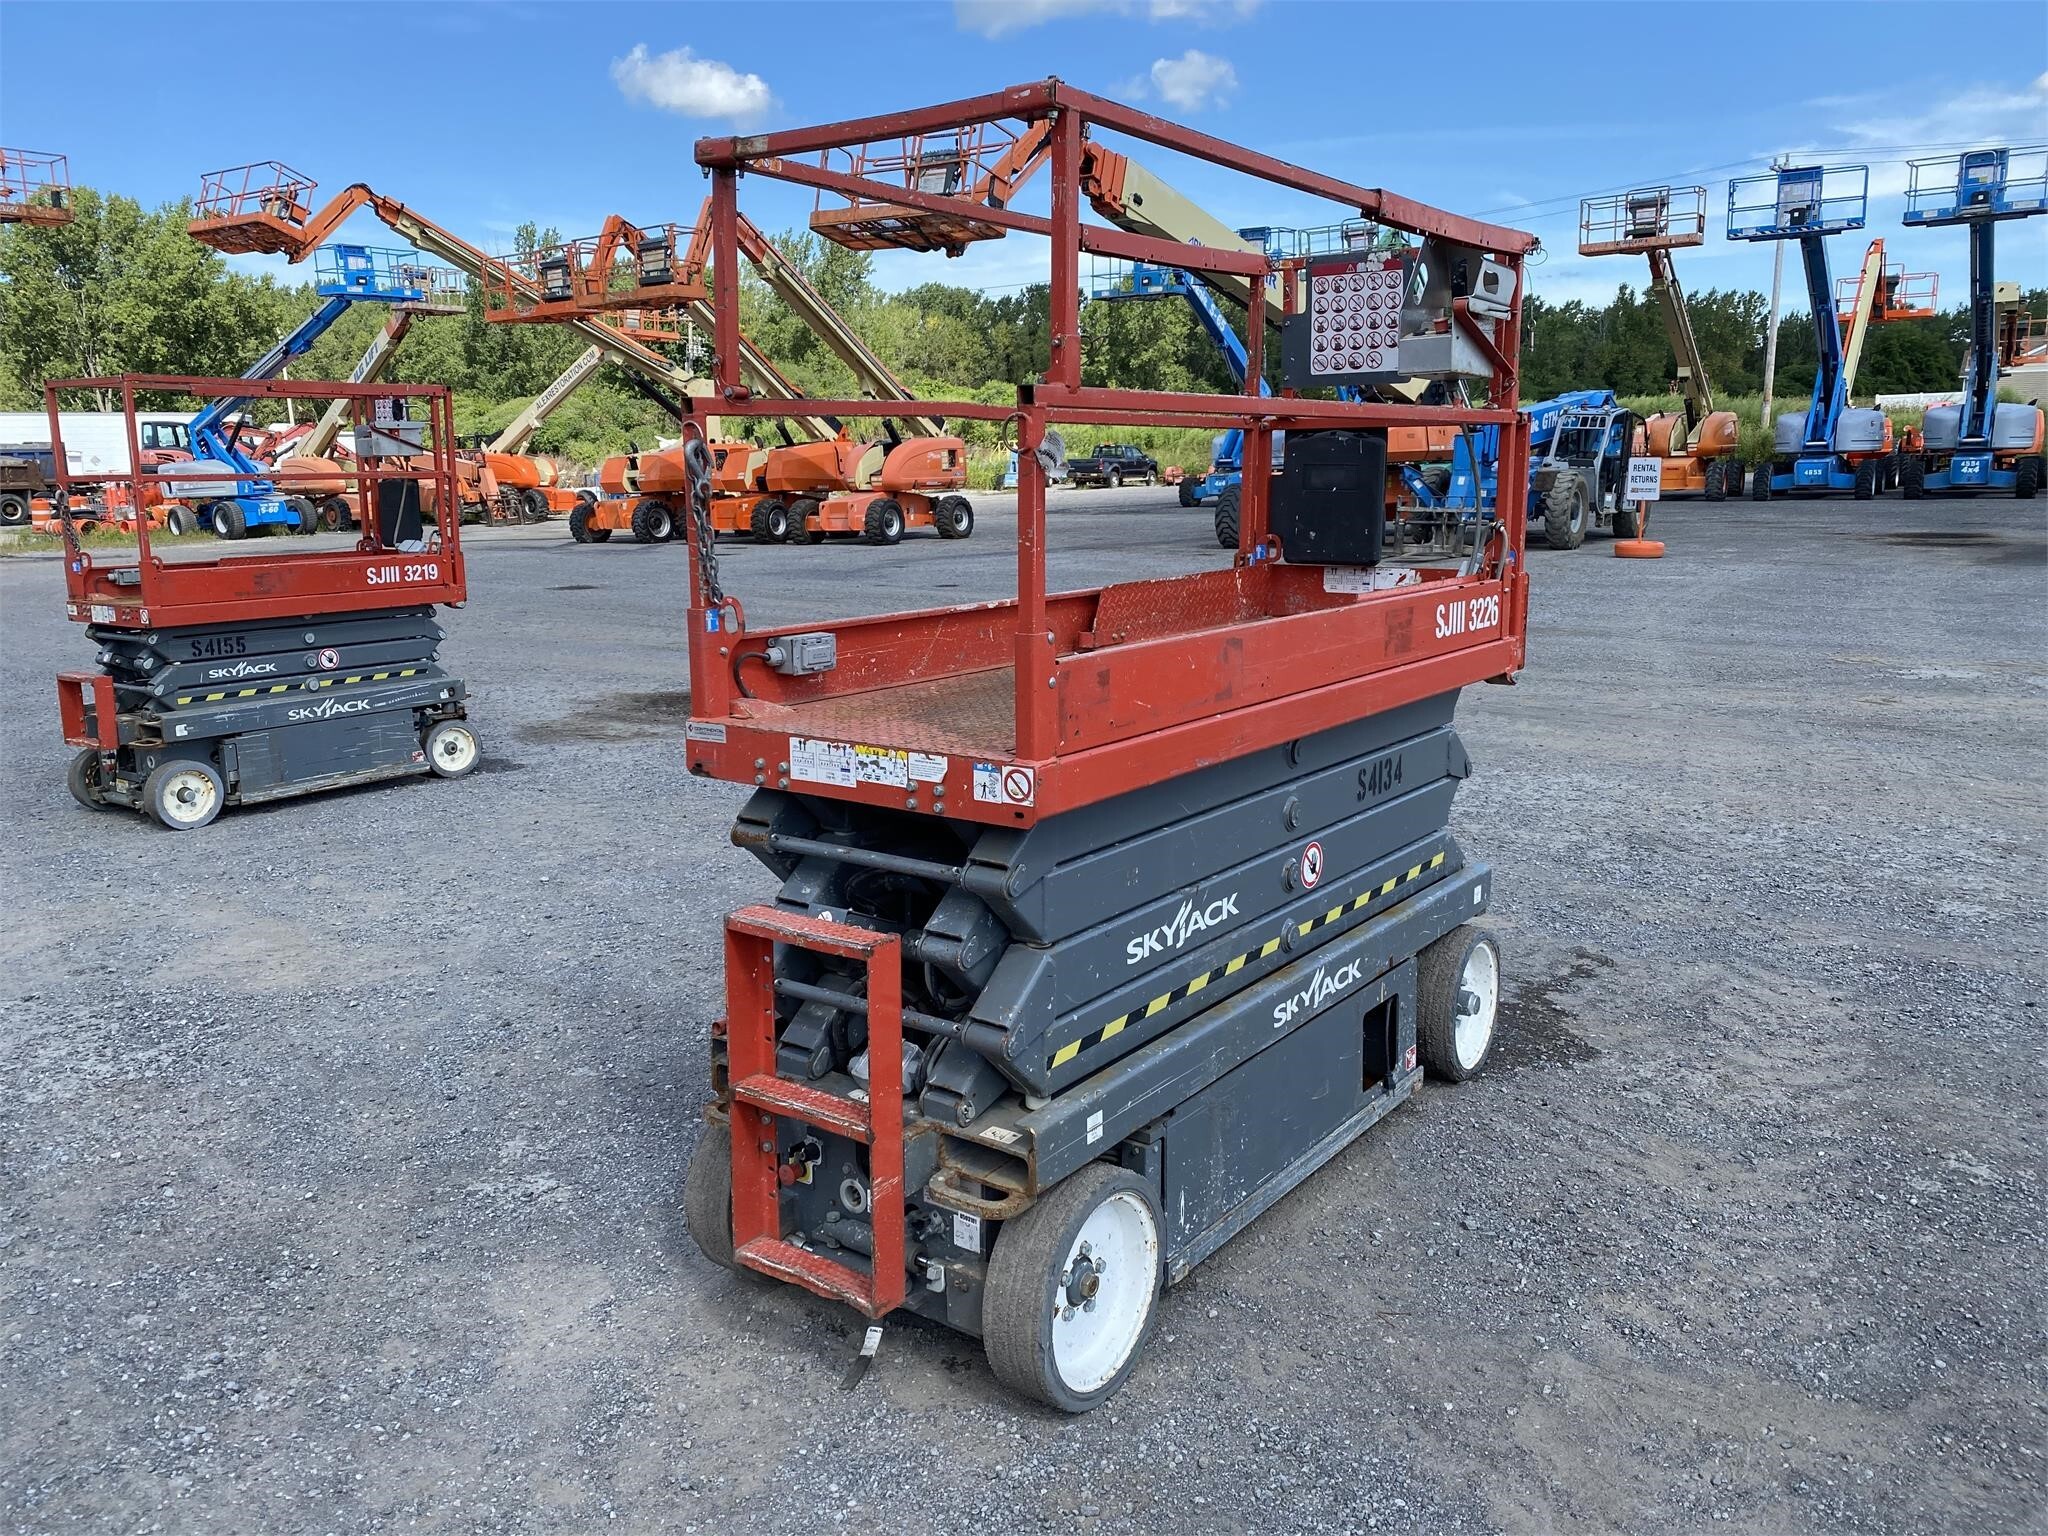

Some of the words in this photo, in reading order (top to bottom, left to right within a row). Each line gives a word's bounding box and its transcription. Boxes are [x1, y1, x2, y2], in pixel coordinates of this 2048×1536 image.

[364, 342, 378, 368] LIFT
[1633, 463, 1657, 472] RENTAL
[1630, 475, 1658, 483] RETURNS
[260, 506, 279, 514] S-60
[366, 566, 400, 585] SJIII
[404, 563, 438, 582] 3219
[1435, 600, 1466, 639] SJIII
[1468, 594, 1499, 632] 3226
[191, 635, 247, 657] S4155
[208, 661, 277, 679] SKYJACK
[287, 698, 371, 720] SKYJACK
[1356, 753, 1402, 802] S4134
[1126, 892, 1240, 965] SKYJACK
[1273, 958, 1362, 1029] SKYJACK
